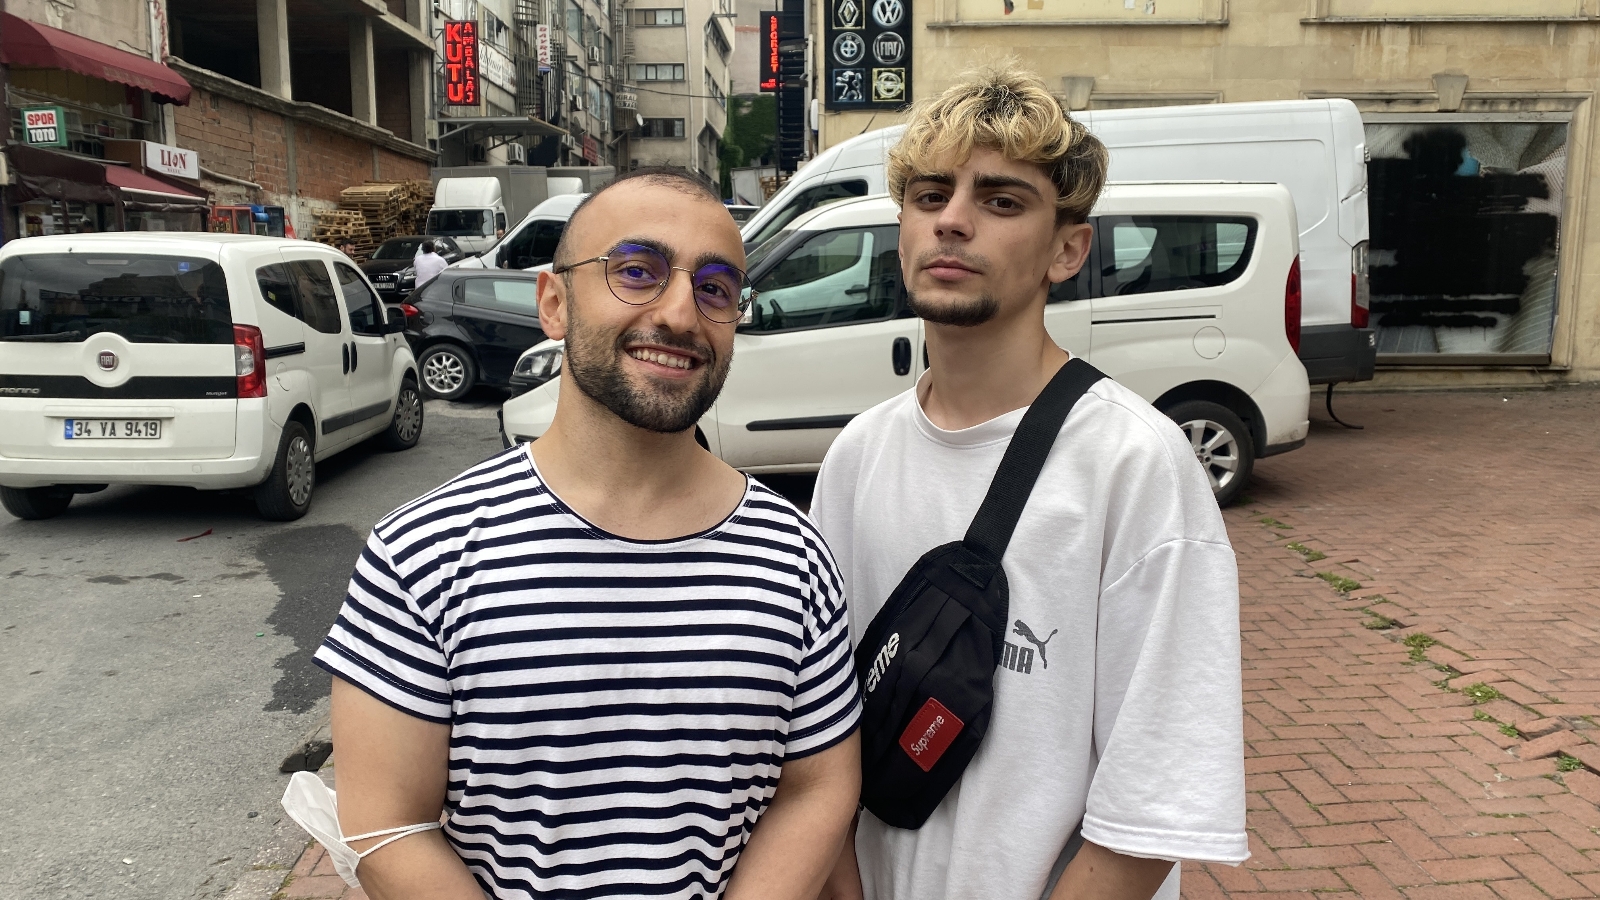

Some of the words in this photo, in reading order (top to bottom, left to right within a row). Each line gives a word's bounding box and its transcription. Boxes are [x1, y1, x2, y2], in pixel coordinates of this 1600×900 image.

[539, 26, 548, 62] BAYRAK
[880, 41, 898, 56] FIAT
[446, 23, 463, 102] KUTU
[463, 22, 474, 103] AMBALAJ
[27, 112, 55, 126] SPOR
[29, 128, 56, 142] TOTO
[160, 149, 187, 169] LION
[100, 355, 114, 366] FIAT
[74, 421, 92, 437] 34
[99, 421, 117, 437] VA
[124, 421, 159, 437] 9419
[863, 632, 900, 702] eme
[998, 640, 1035, 675] MA
[911, 715, 945, 756] Supreme
